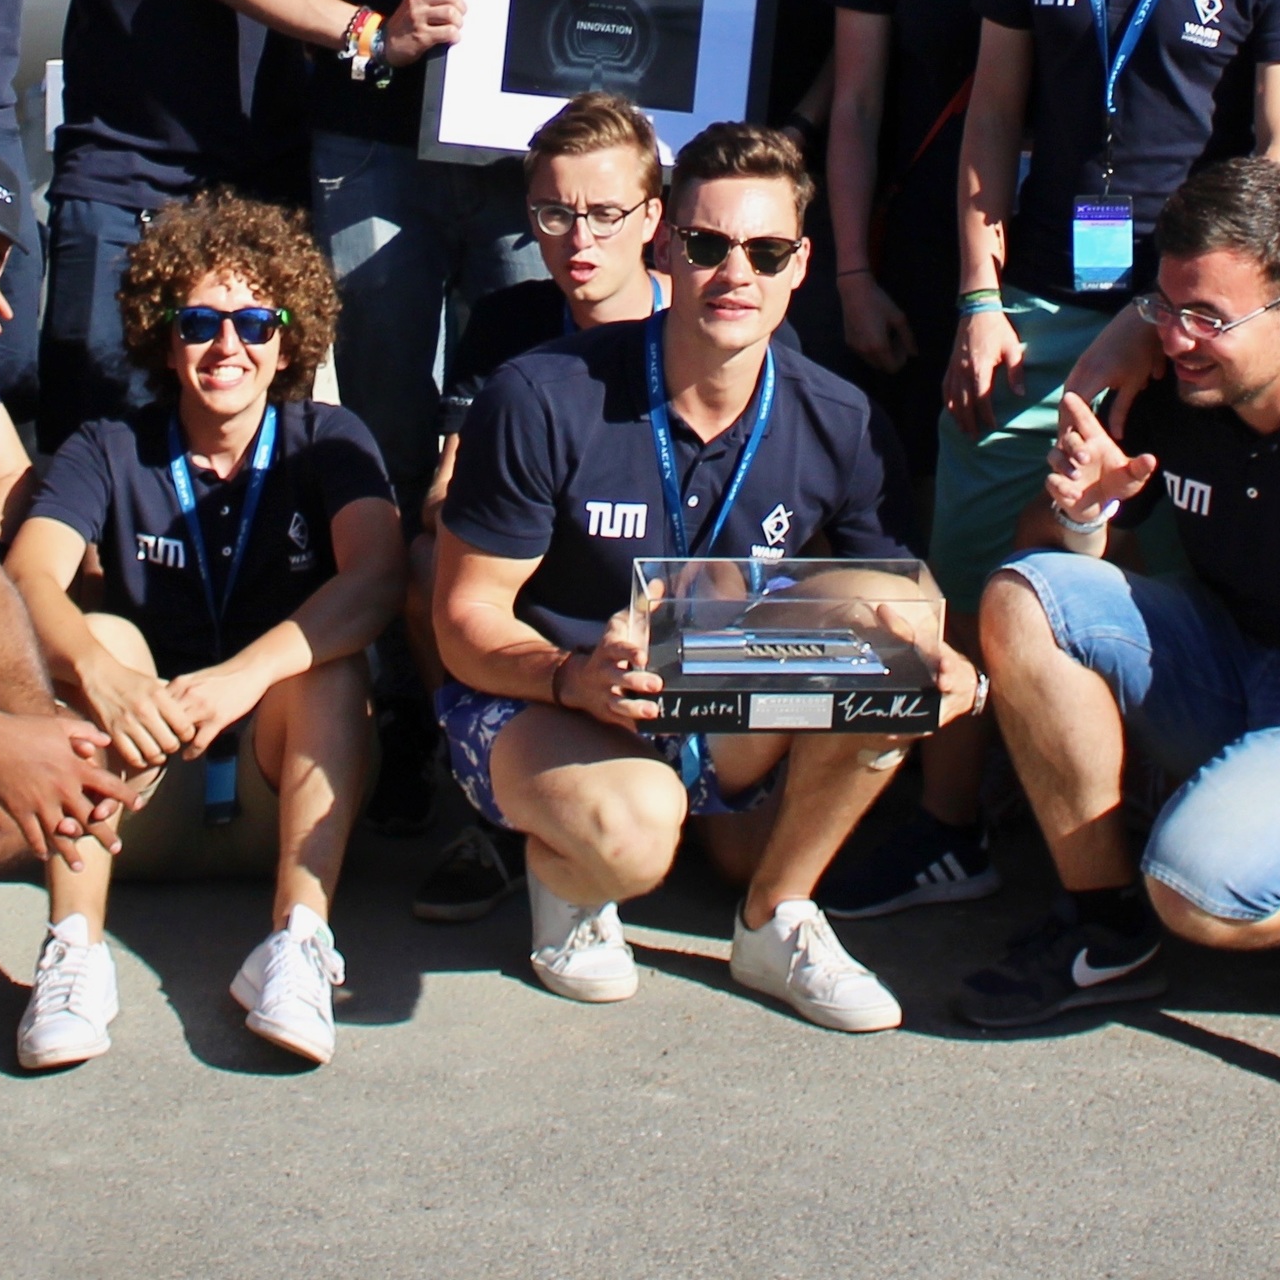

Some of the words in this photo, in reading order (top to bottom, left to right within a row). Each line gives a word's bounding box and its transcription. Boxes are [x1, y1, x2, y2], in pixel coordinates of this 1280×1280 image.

[576, 21, 633, 35] INNOVATION
[1184, 22, 1220, 41] WARR
[657, 427, 672, 480] SPACEX
[1163, 470, 1212, 516] TUM
[586, 501, 648, 539] TUM
[136, 533, 186, 569] TUM
[690, 693, 742, 724] astra!
